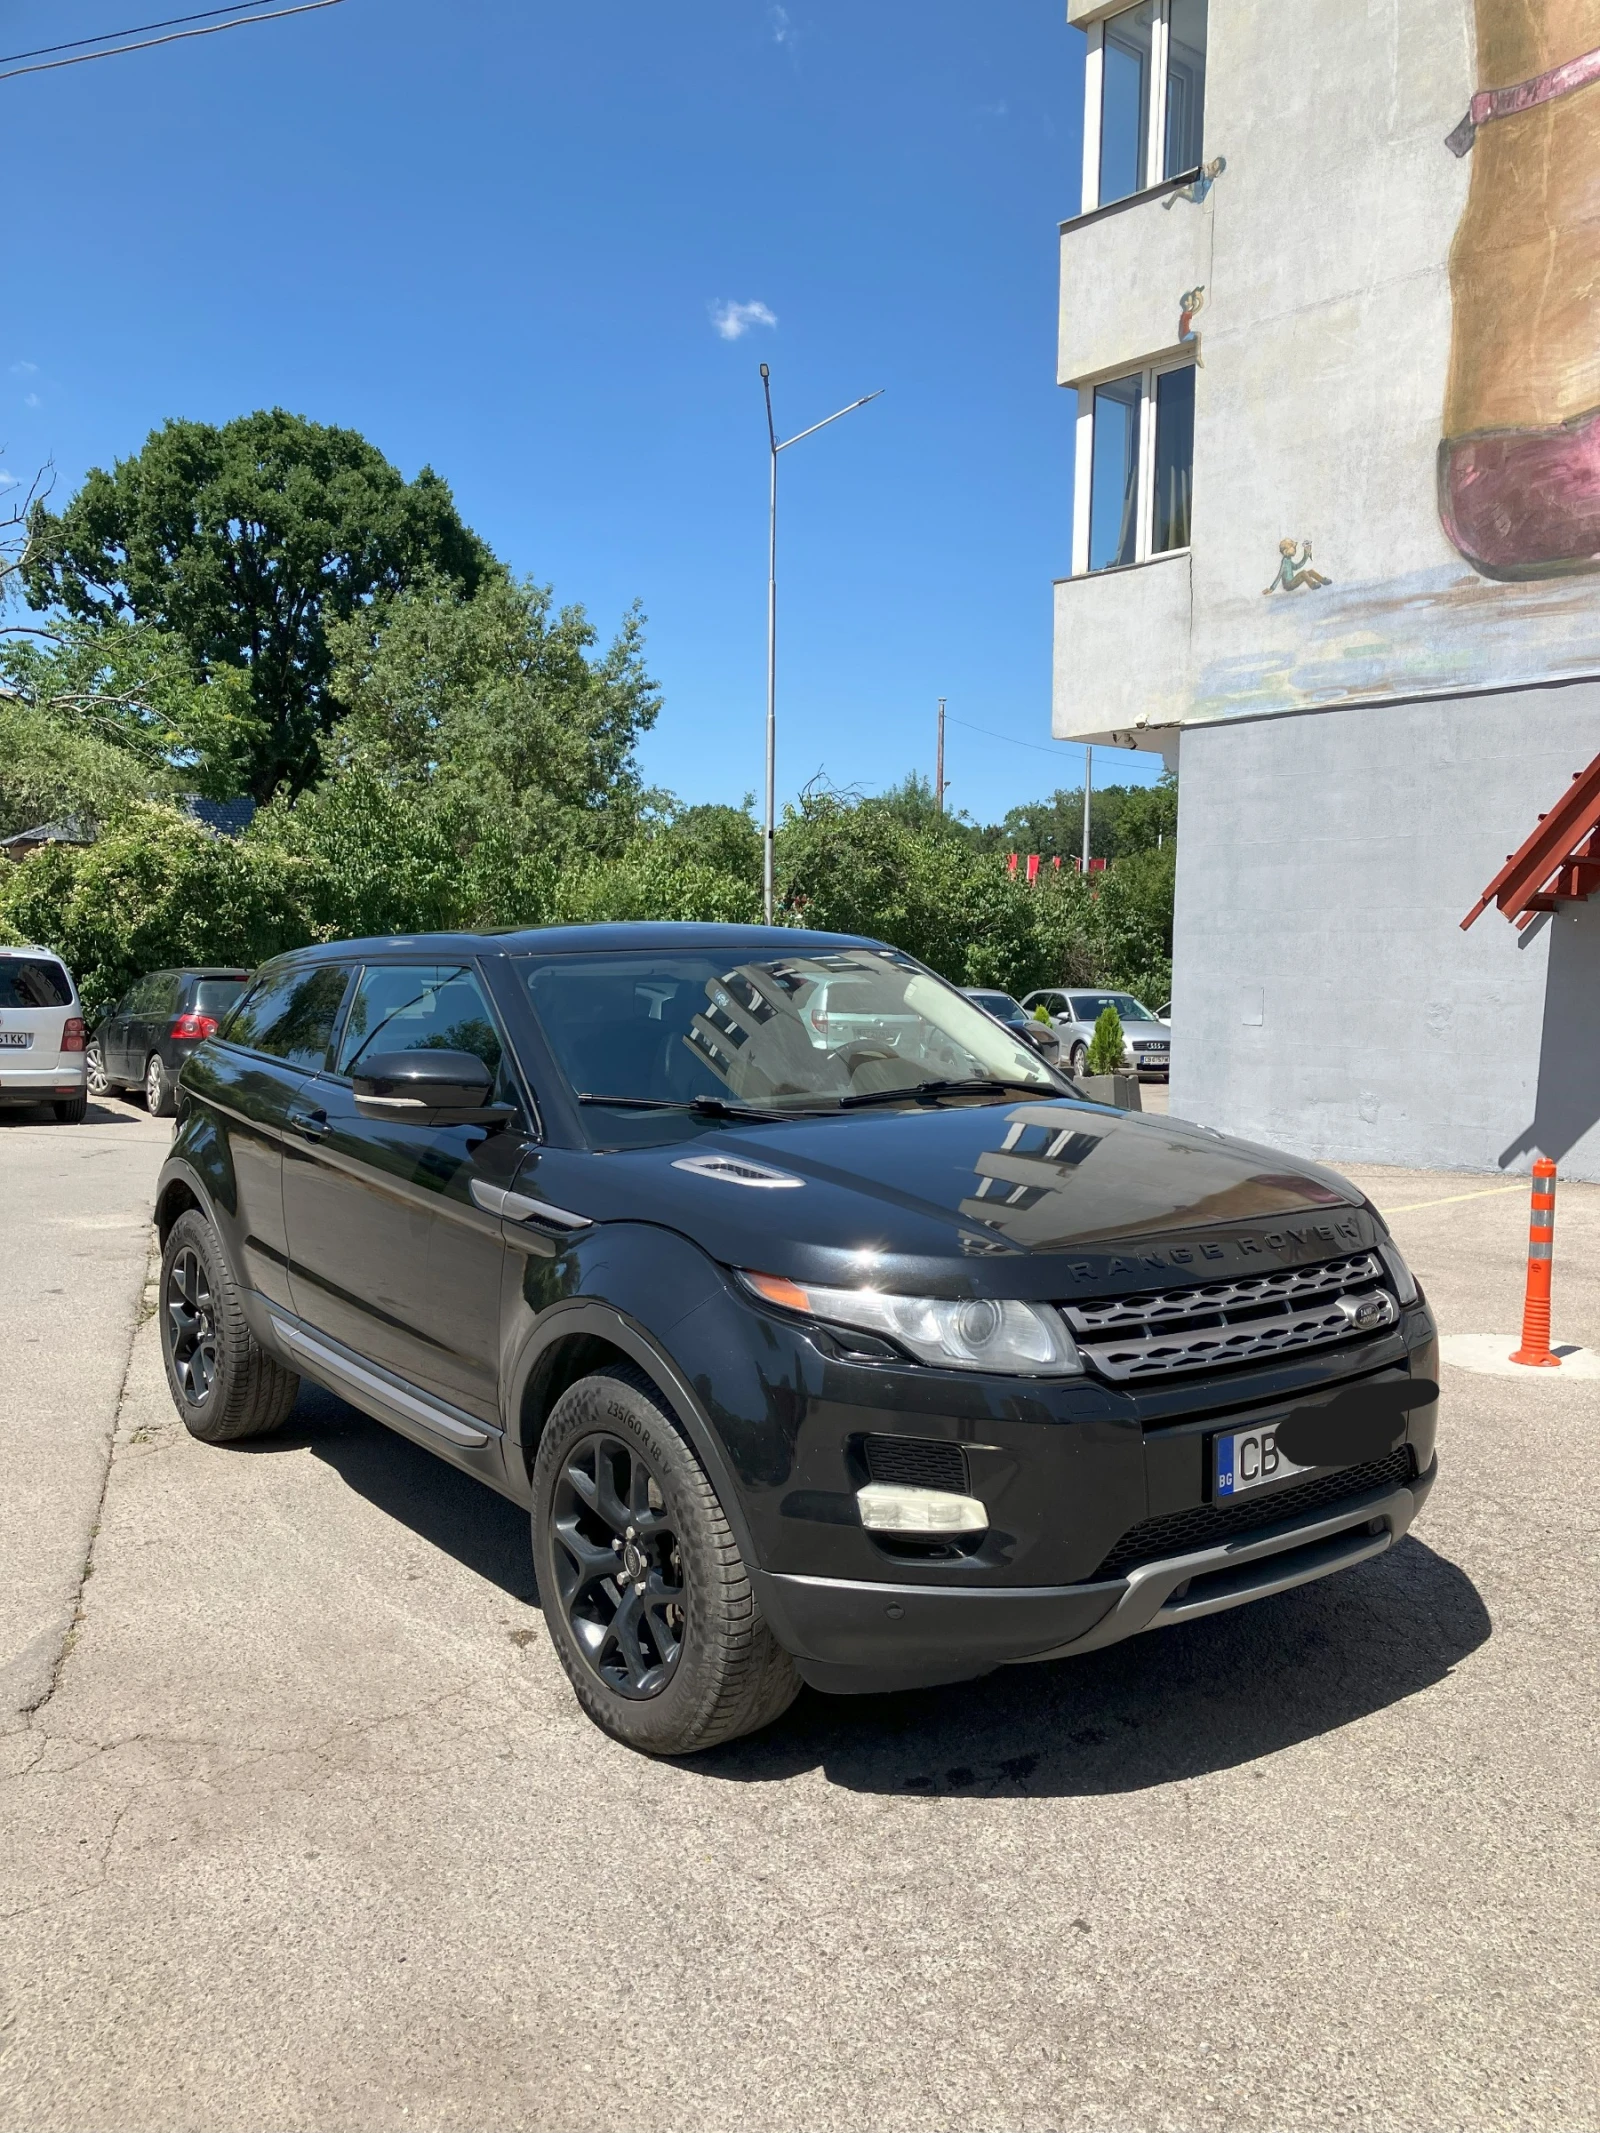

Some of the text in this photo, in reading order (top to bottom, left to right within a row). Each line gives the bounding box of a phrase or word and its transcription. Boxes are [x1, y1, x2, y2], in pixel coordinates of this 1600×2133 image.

[1067, 1222, 1358, 1283] RANGE ROVER
[607, 1400, 642, 1435] 235/60
[642, 1429, 651, 1446] R
[650, 1441, 662, 1461] 18
[1240, 1432, 1280, 1481] CB
[1219, 1472, 1233, 1488] BG
